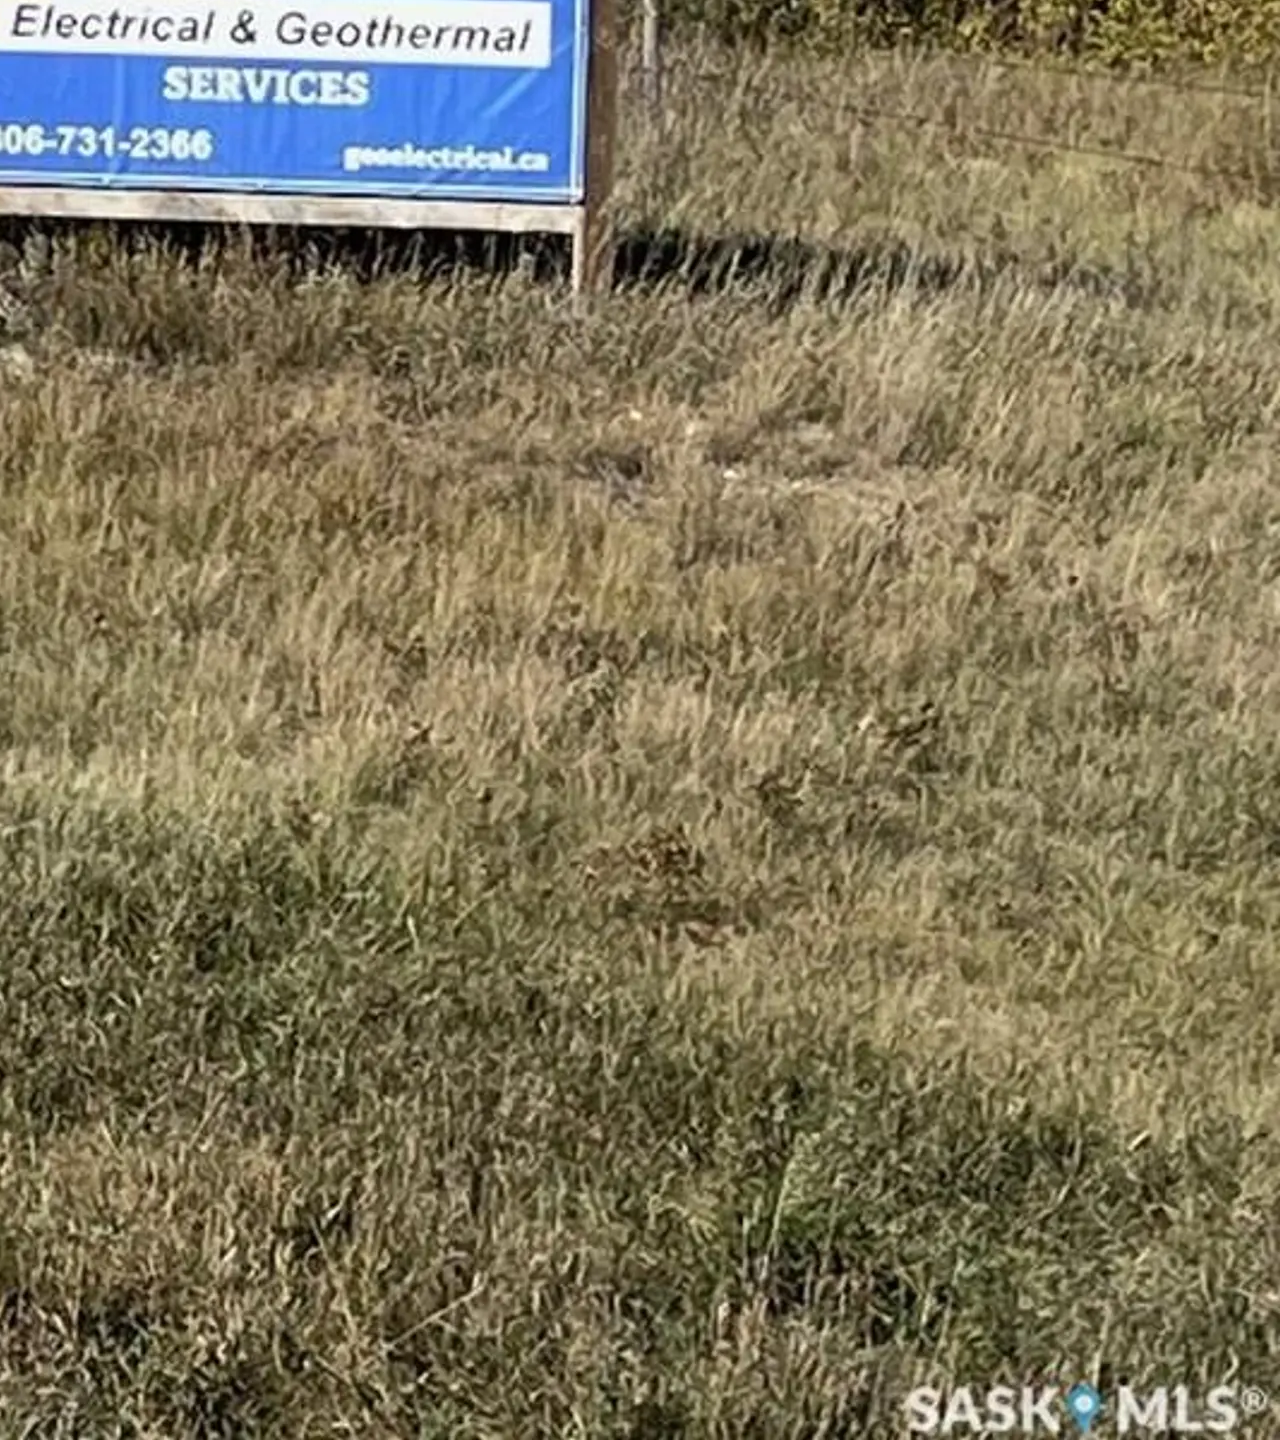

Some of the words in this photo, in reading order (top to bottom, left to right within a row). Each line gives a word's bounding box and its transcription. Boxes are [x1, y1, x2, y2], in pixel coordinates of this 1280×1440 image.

[11, 3, 216, 44] Electrical
[230, 10, 258, 44] &
[276, 10, 532, 54] Geothermal
[162, 66, 370, 105] SERVICES
